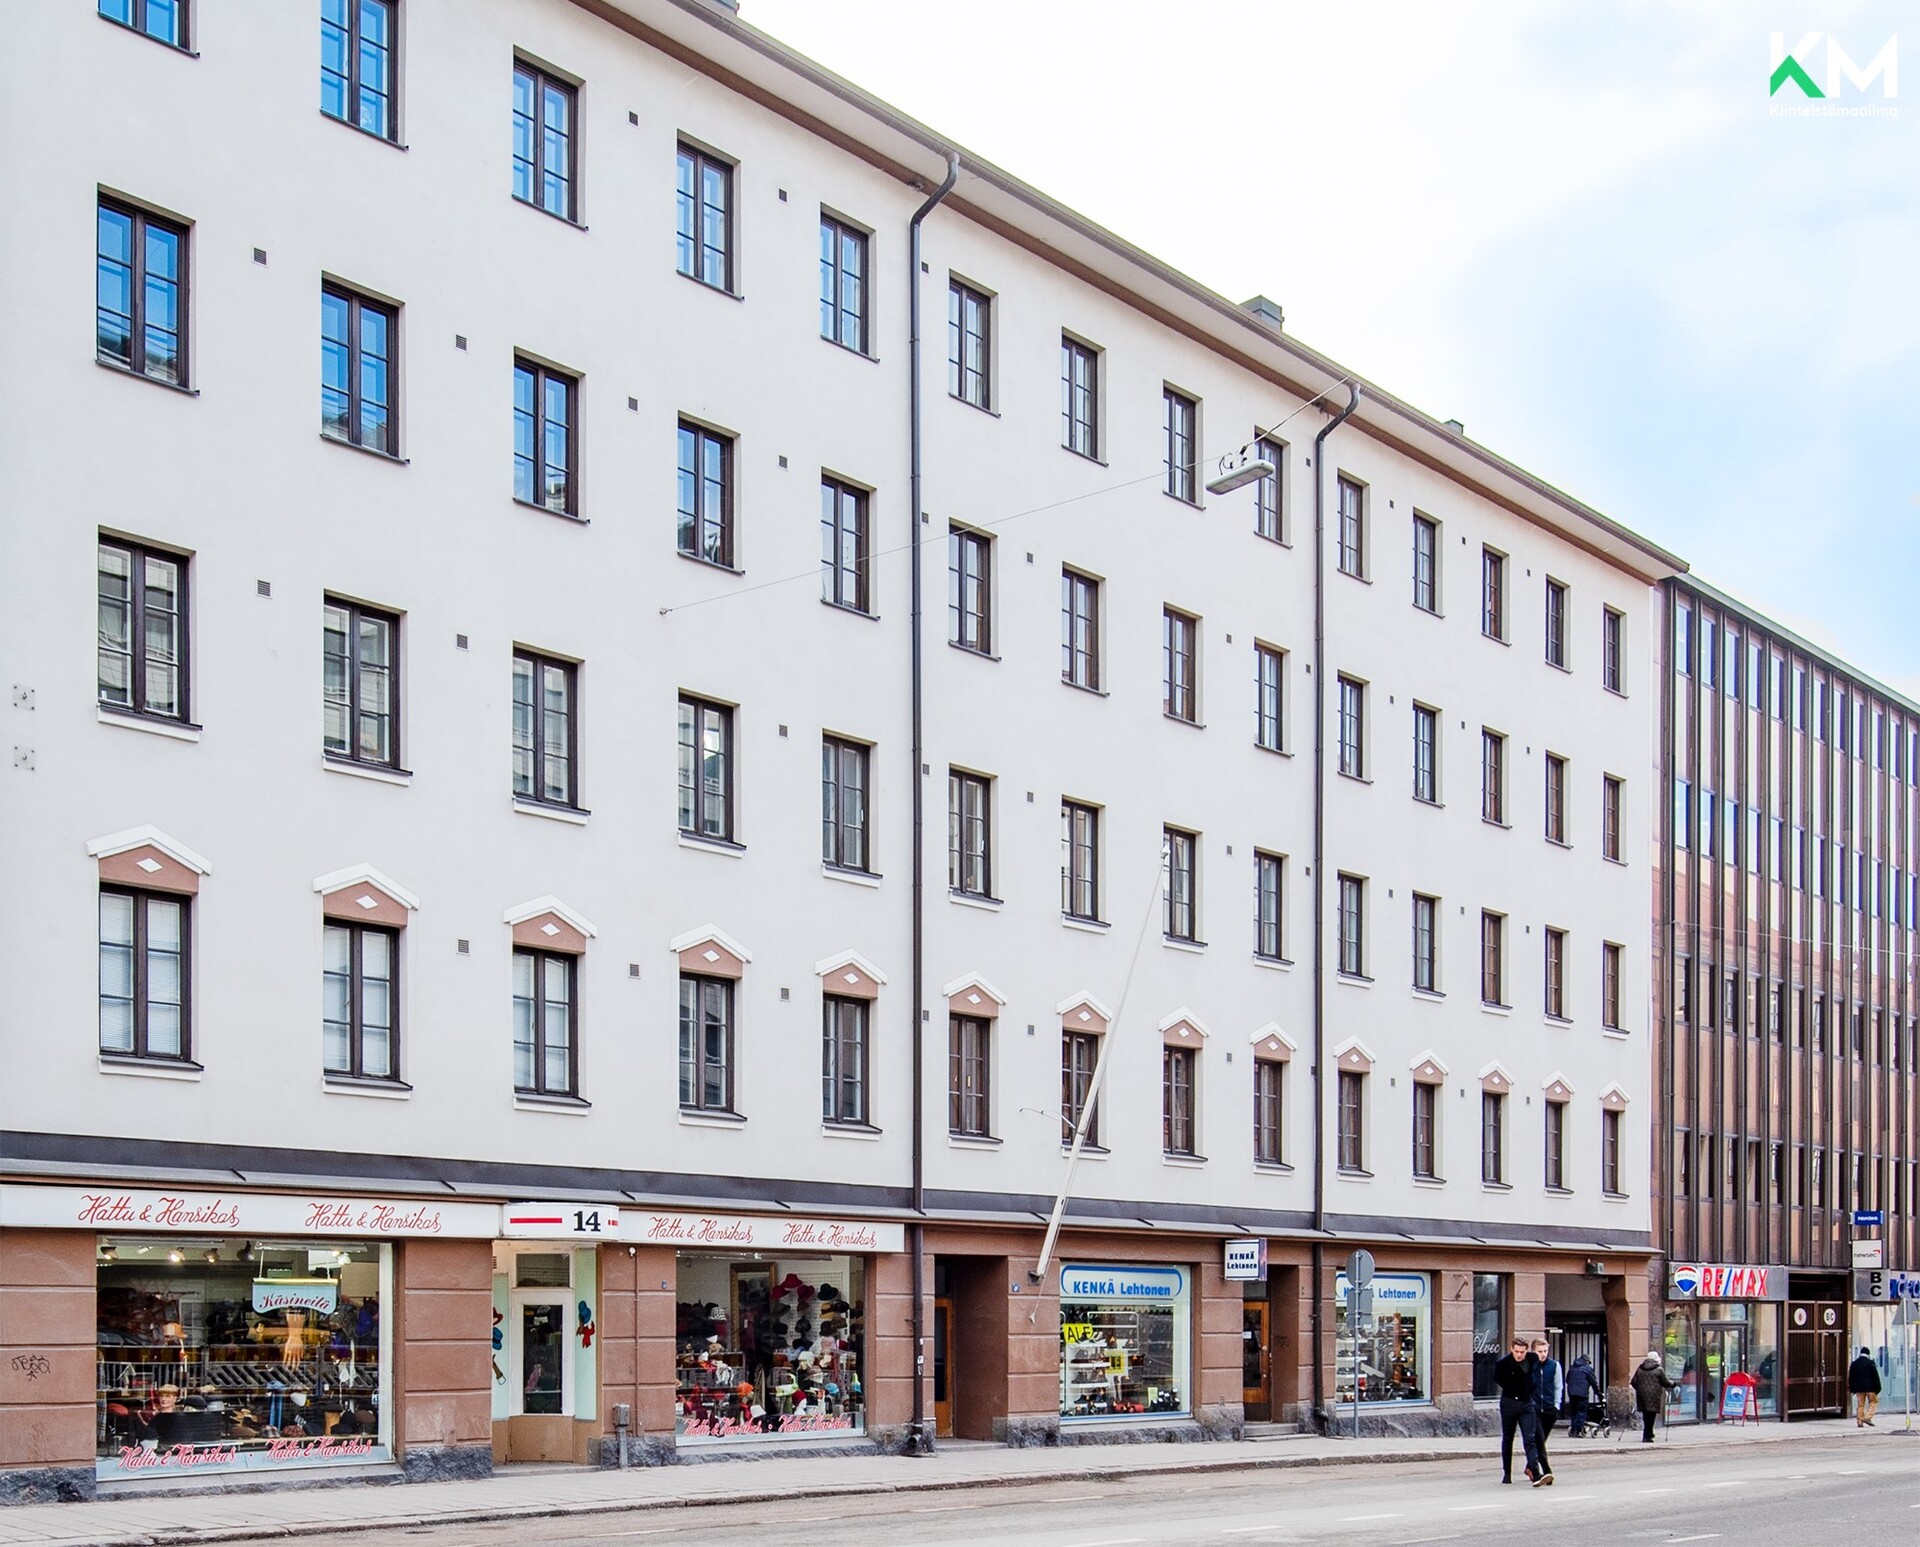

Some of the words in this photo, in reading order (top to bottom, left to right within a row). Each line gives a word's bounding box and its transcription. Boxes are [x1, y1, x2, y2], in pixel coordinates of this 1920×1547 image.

[78, 1195, 135, 1224] Hattu
[139, 1204, 152, 1223] &
[155, 1197, 240, 1228] Hansikas
[304, 1202, 352, 1230] Hattu
[356, 1212, 368, 1229] &
[370, 1204, 442, 1233] Hansikas
[573, 1210, 601, 1232] 14
[647, 1216, 684, 1240] Hattu
[686, 1224, 696, 1239] &
[698, 1218, 753, 1244] Hansikas
[782, 1222, 816, 1245] Hattu
[818, 1230, 826, 1244] &
[827, 1225, 877, 1249] Hansikas
[1229, 1251, 1255, 1260] KENKÄ
[1073, 1278, 1115, 1295] KENKÄ
[1121, 1282, 1171, 1296] Lehtonen
[1702, 1267, 1769, 1297] RE/MAX
[1870, 1272, 1882, 1284] B
[259, 1292, 331, 1310] Käsineitä
[1378, 1287, 1417, 1299] Lehtonen
[1870, 1285, 1882, 1297] C
[1473, 1329, 1500, 1354] Avec
[118, 1445, 158, 1470] Hattu
[171, 1443, 237, 1468] Hansikas
[265, 1438, 301, 1463] Hattu
[313, 1434, 373, 1461] Hansikas
